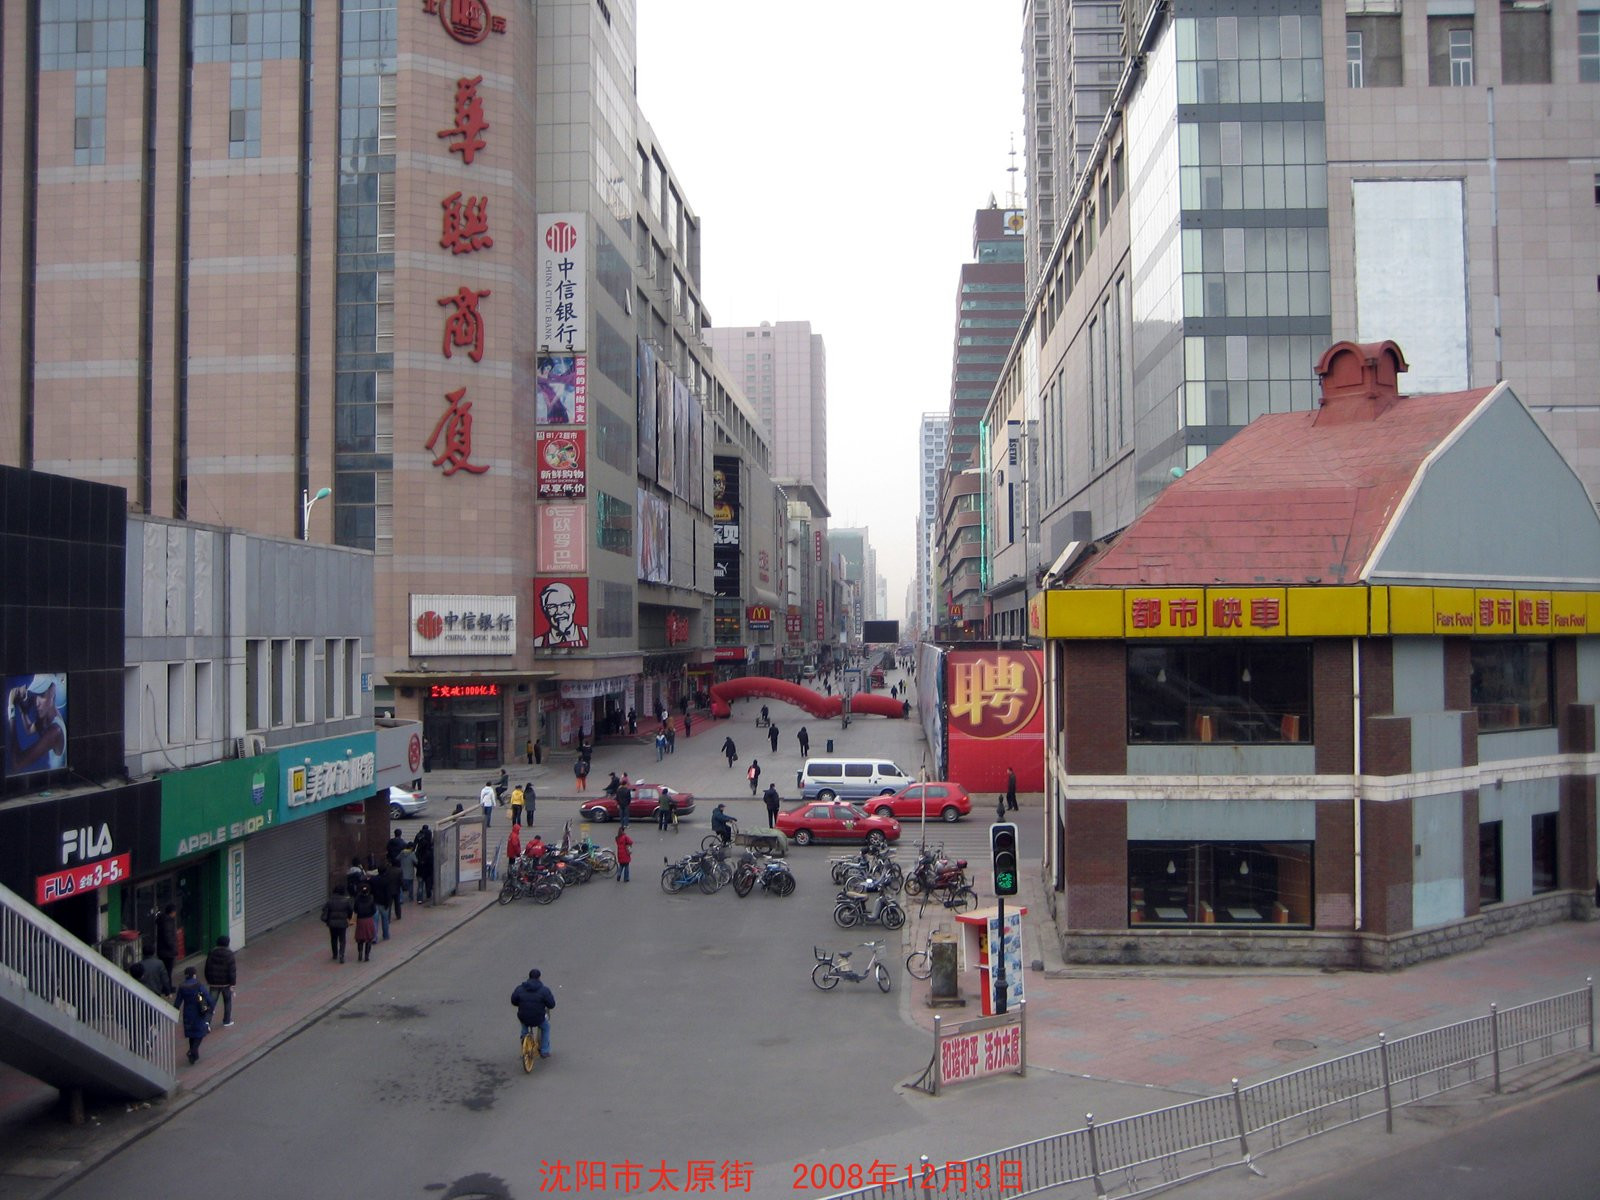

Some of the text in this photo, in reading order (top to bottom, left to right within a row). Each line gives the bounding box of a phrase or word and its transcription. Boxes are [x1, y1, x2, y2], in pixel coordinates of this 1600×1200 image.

[545, 259, 553, 340] CHINA CITIC BANK
[554, 257, 578, 344] 中信银行
[444, 611, 514, 632] 中信银行
[949, 656, 1028, 726] 聘
[61, 822, 113, 865] FILA
[176, 815, 264, 857] APPLE SHOP
[45, 873, 76, 901] FILA
